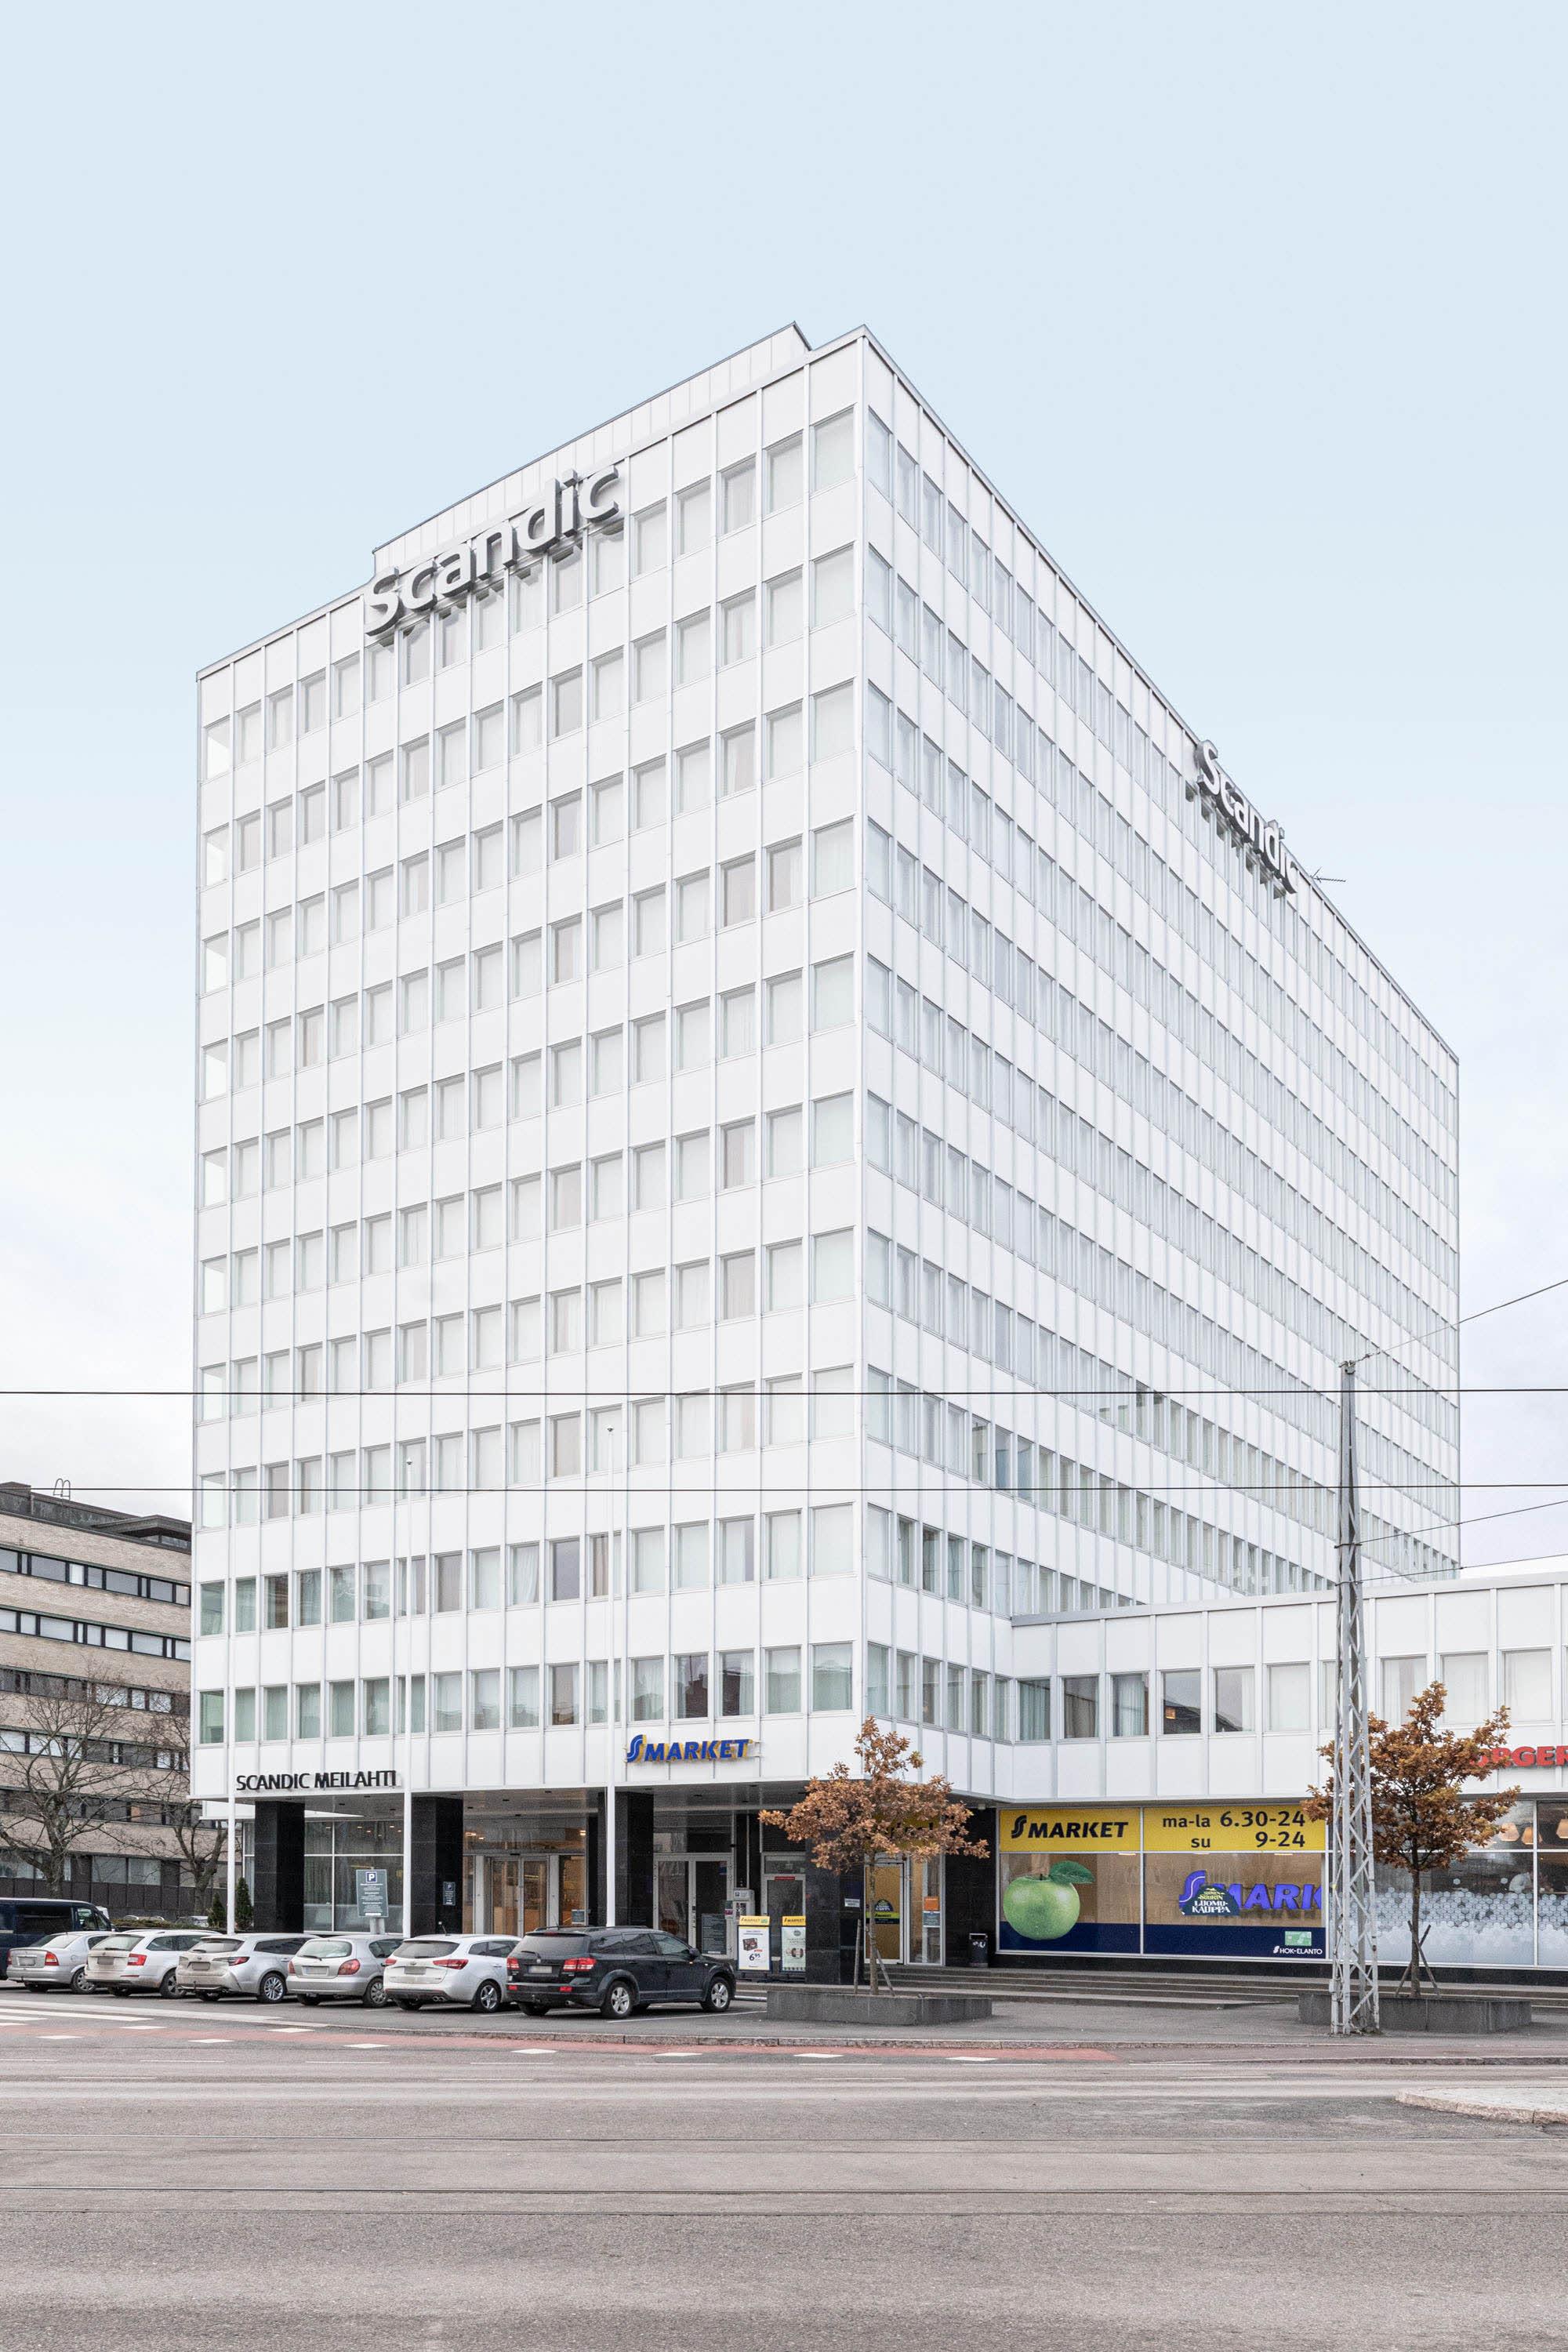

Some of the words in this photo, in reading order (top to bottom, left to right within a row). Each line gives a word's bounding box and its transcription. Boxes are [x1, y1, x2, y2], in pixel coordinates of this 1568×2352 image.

[364, 465, 620, 636] Scandic
[1196, 740, 1299, 894] Scandic
[236, 1773, 310, 1791] SCANDIC
[314, 1770, 397, 1788] MEILAHTI
[1163, 1814, 1210, 1828] ma-la
[1220, 1811, 1305, 1828] 6.30-24
[1191, 1838, 1210, 1848] su
[1255, 1831, 1305, 1847] 9-24
